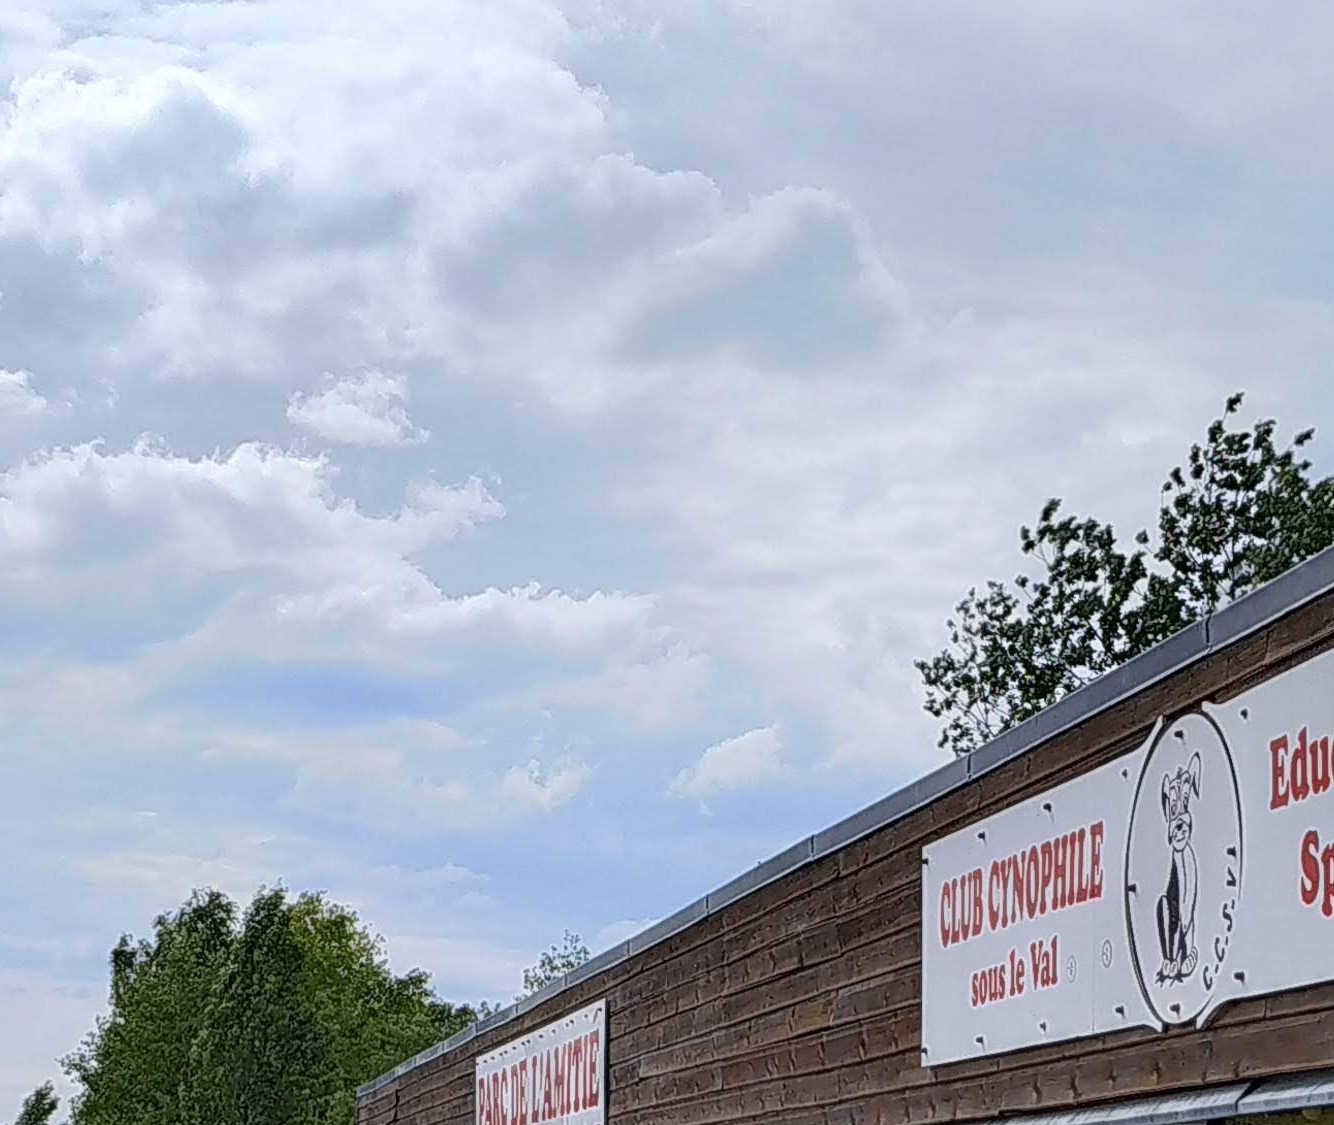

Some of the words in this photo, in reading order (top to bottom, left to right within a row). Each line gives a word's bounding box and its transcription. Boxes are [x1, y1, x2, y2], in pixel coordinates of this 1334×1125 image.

[940, 867, 984, 948] CLUB
[988, 820, 1104, 931] CYNOPHILE
[971, 964, 1006, 1007] sous
[1009, 949, 1025, 996] le
[1030, 935, 1058, 990] Val
